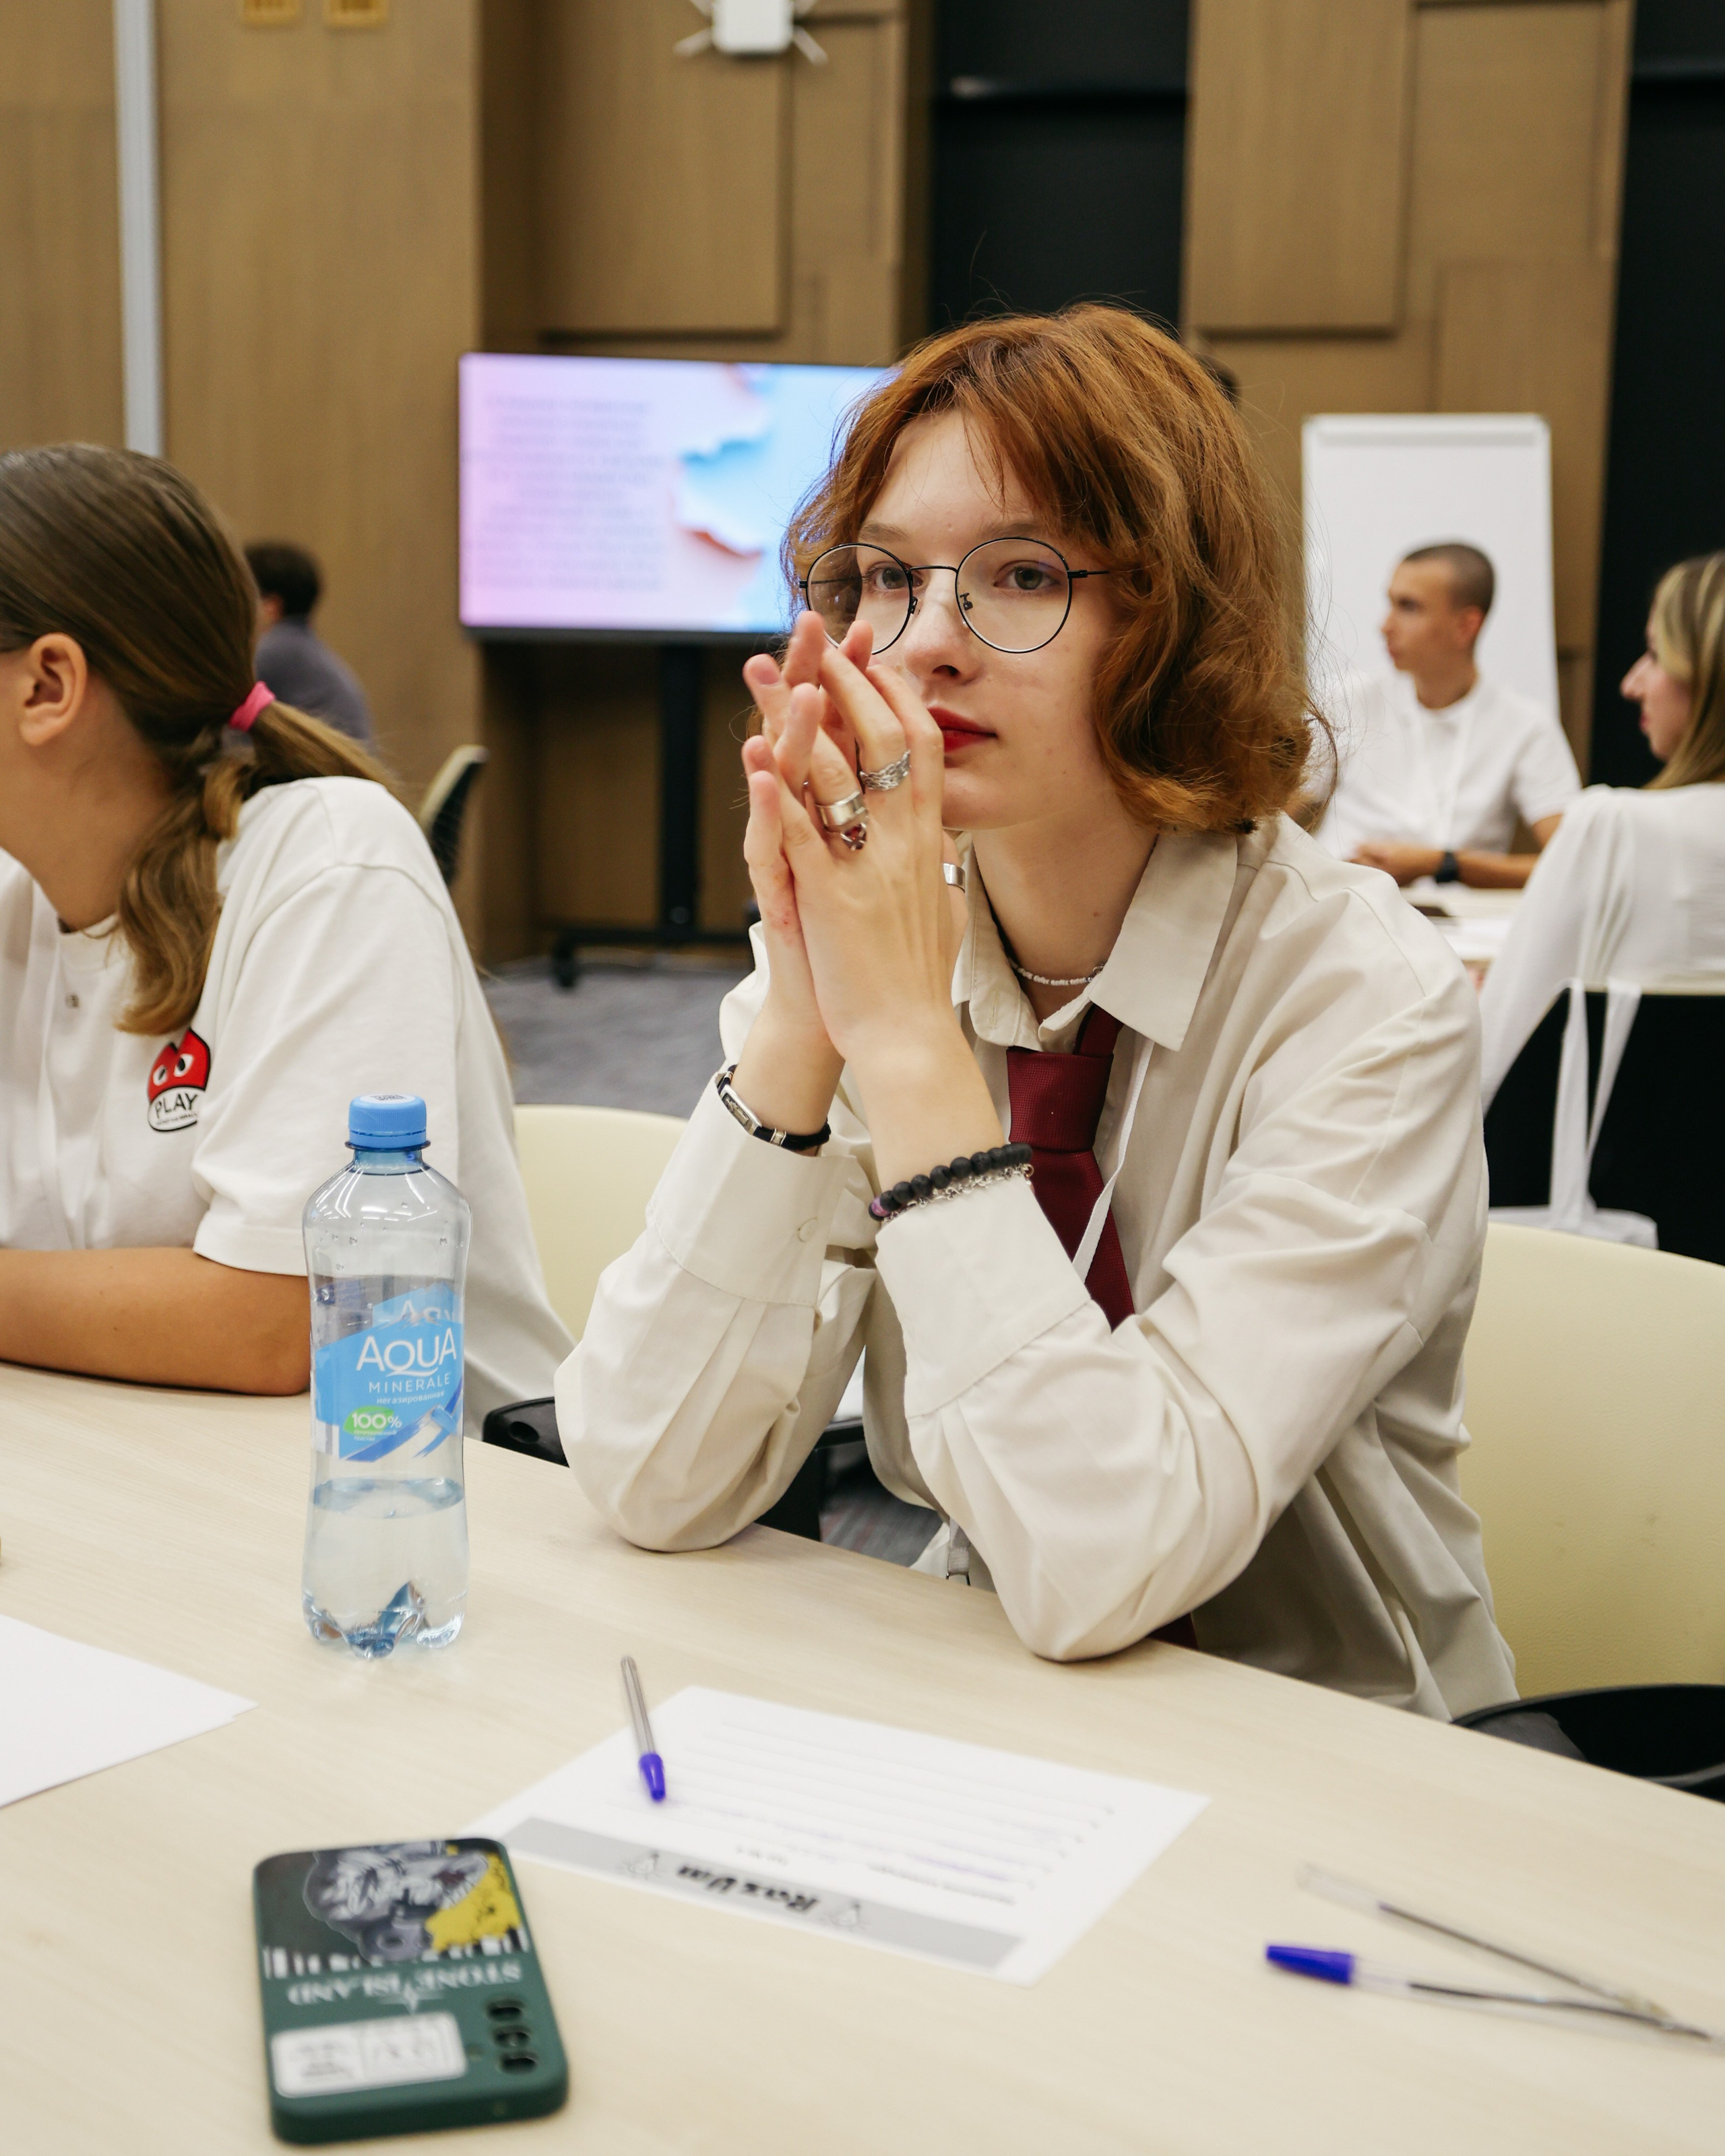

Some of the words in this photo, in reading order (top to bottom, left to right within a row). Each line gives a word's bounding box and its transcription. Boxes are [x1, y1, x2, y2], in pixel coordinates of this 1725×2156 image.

[154, 1093, 199, 1118] PLAY
[356, 1327, 457, 1377] AQUA
[369, 1372, 451, 1393] MINERALE
[377, 1391, 445, 1405] негазированная
[352, 1413, 402, 1429] 100%
[415, 1960, 522, 1990] STONE
[288, 1972, 401, 2005] ISLAND
